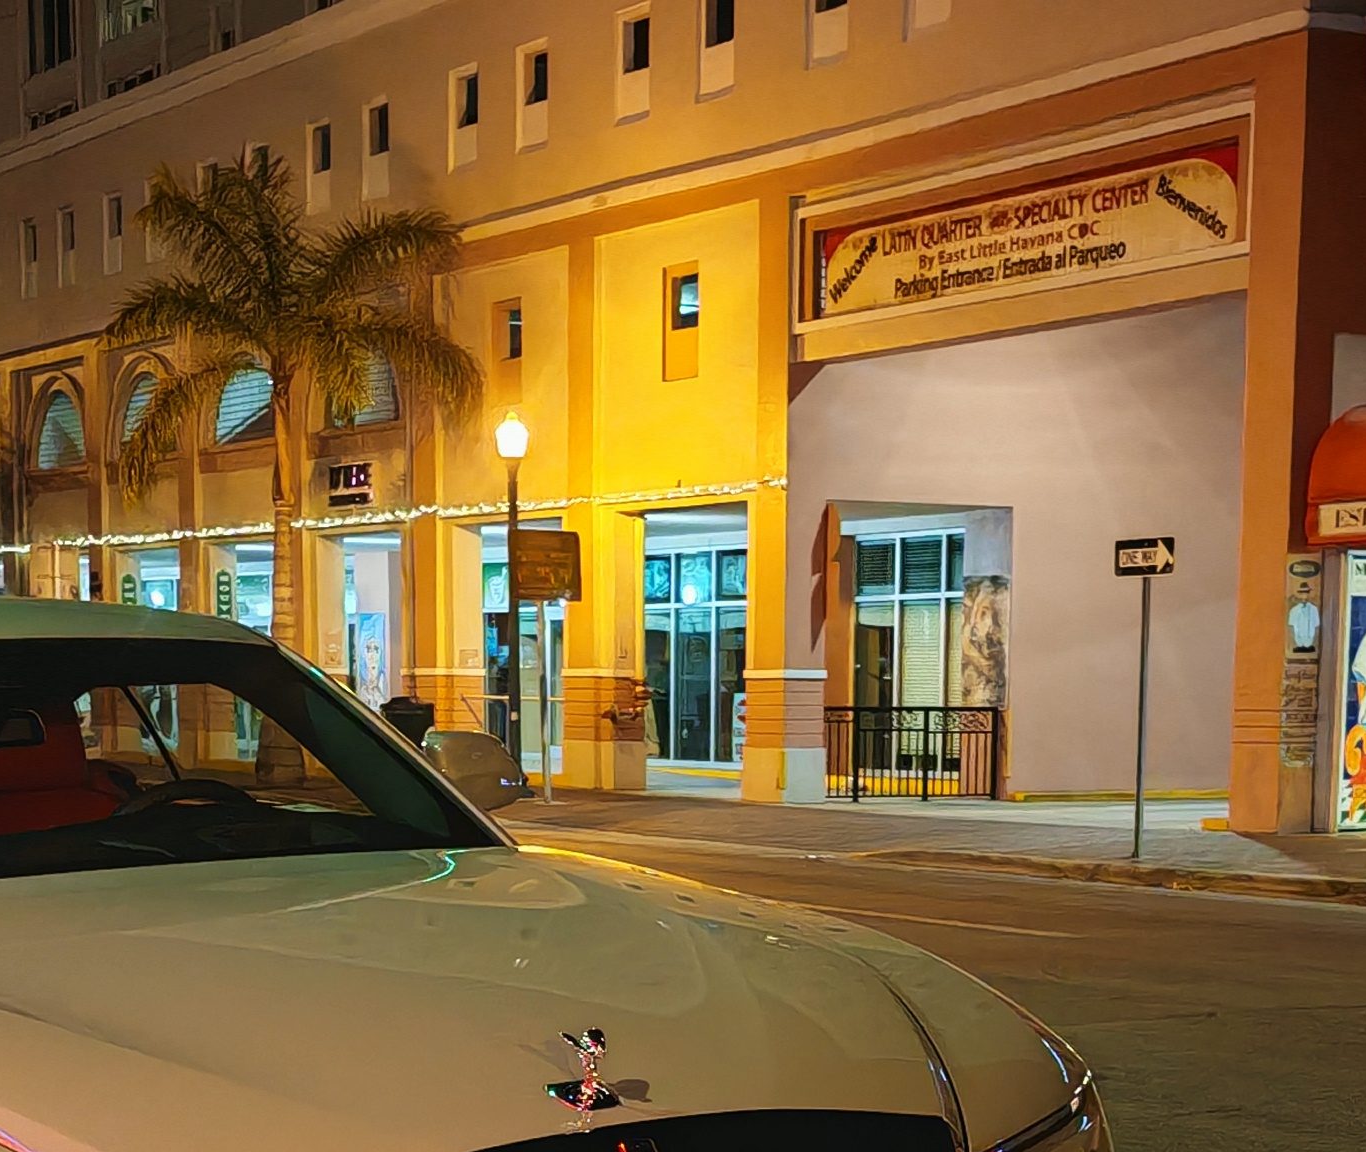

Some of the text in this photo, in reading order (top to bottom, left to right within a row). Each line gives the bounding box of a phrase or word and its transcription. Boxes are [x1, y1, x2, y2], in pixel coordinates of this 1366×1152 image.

[881, 227, 919, 258] LATIN
[920, 214, 983, 250] QUARTER
[1013, 191, 1089, 230] SPECIALTY
[1091, 180, 1150, 213] CENTER
[1155, 174, 1229, 240] Bienvenidos
[829, 234, 878, 304] Welcome
[893, 272, 939, 299] Parking
[941, 265, 995, 291] Entrance
[1002, 249, 1053, 280] Entrada
[1054, 248, 1067, 270] al
[1068, 241, 1127, 270] Parqueo
[919, 254, 935, 271] By
[938, 249, 967, 266] East
[969, 241, 1006, 260] Little
[1010, 230, 1064, 253] Havana
